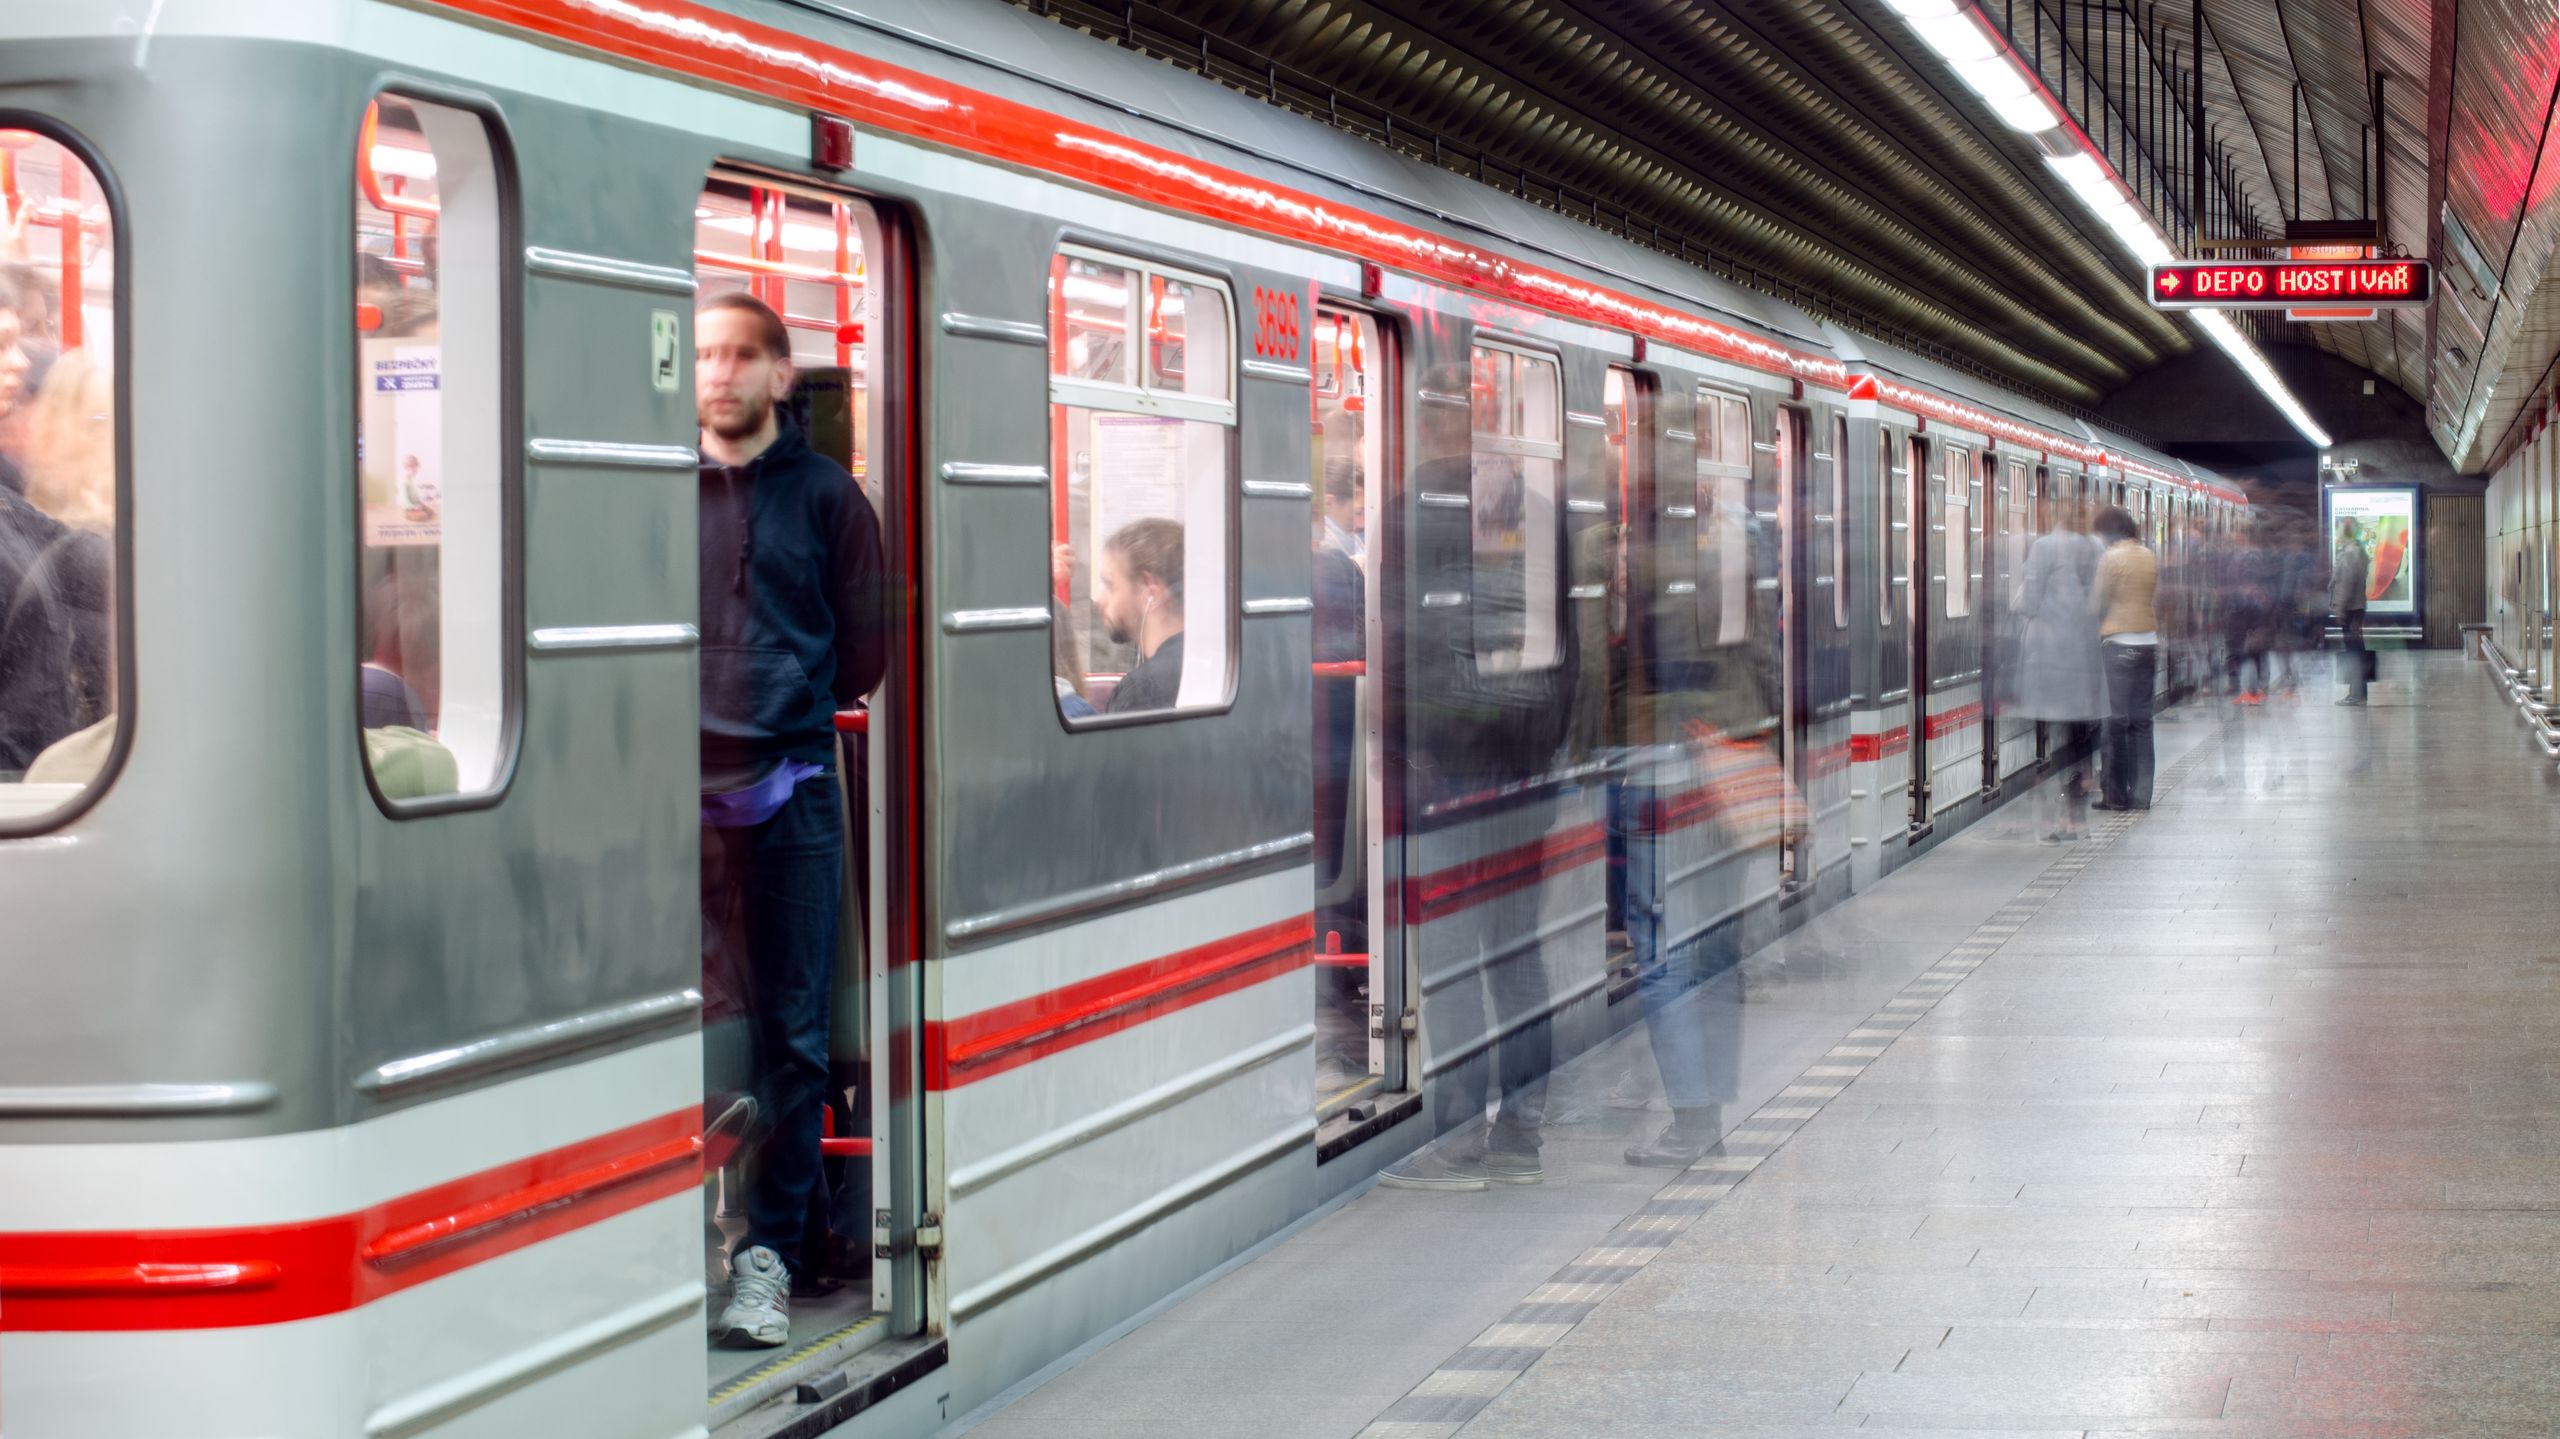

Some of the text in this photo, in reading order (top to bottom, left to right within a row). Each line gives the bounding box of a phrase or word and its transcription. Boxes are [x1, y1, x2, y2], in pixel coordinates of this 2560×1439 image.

[2197, 265, 2408, 292] DEPO HOSTIVAŘ
[1253, 284, 1299, 361] 3699
